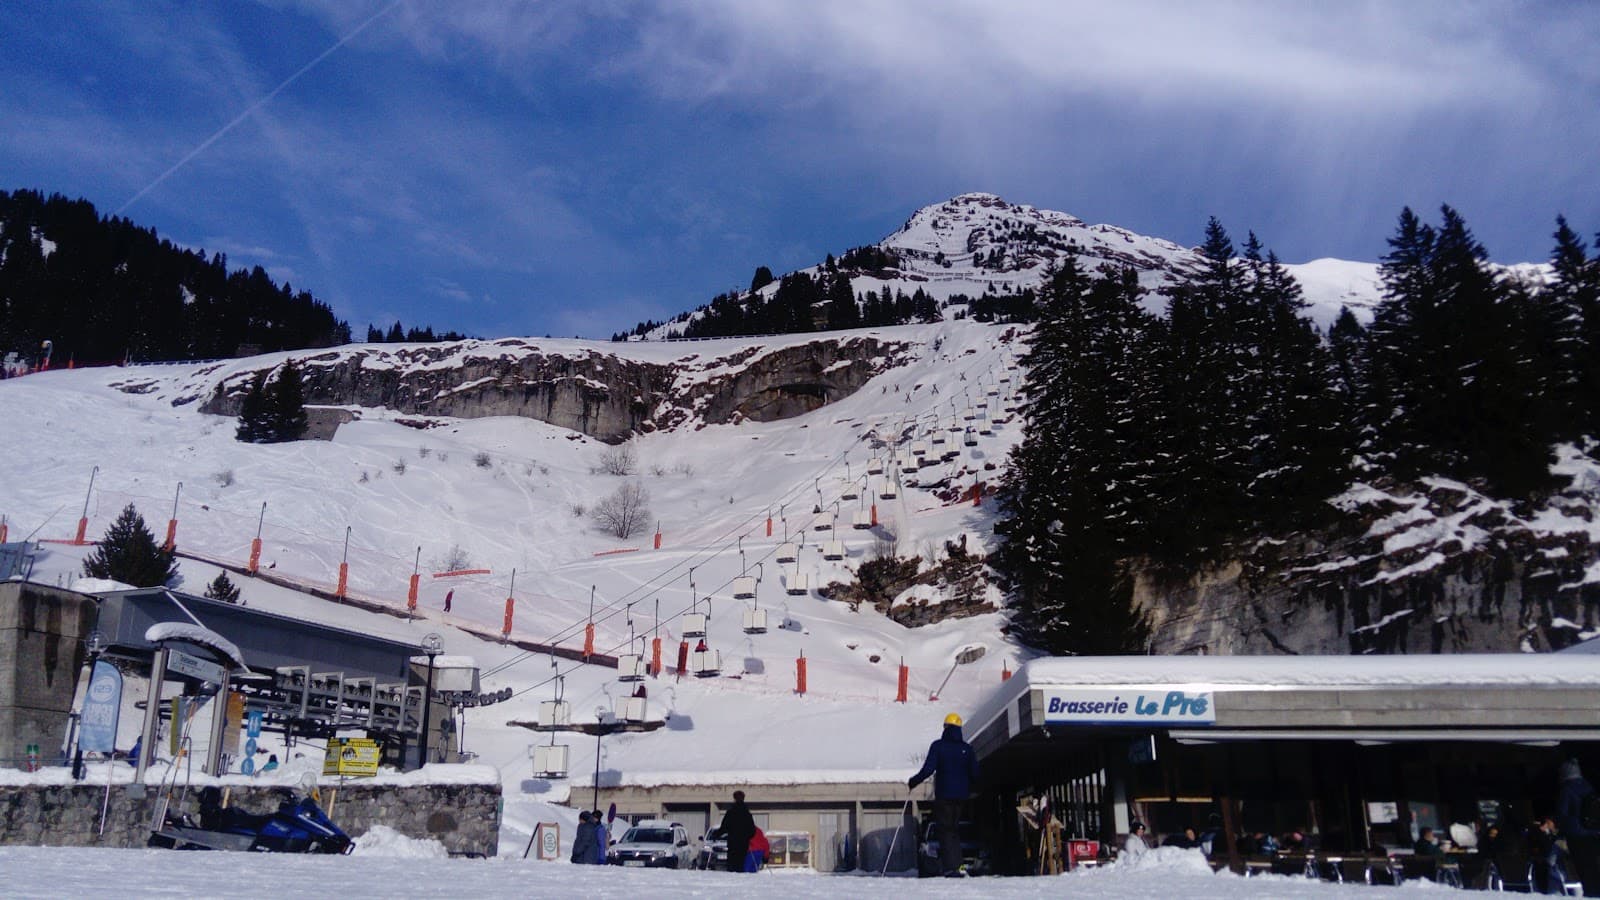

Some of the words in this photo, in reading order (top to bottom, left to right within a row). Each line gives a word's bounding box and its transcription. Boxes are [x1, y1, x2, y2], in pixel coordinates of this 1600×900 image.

[1048, 696, 1129, 714] Brasserie
[1135, 695, 1159, 715] Le
[1161, 690, 1210, 716] Pré
